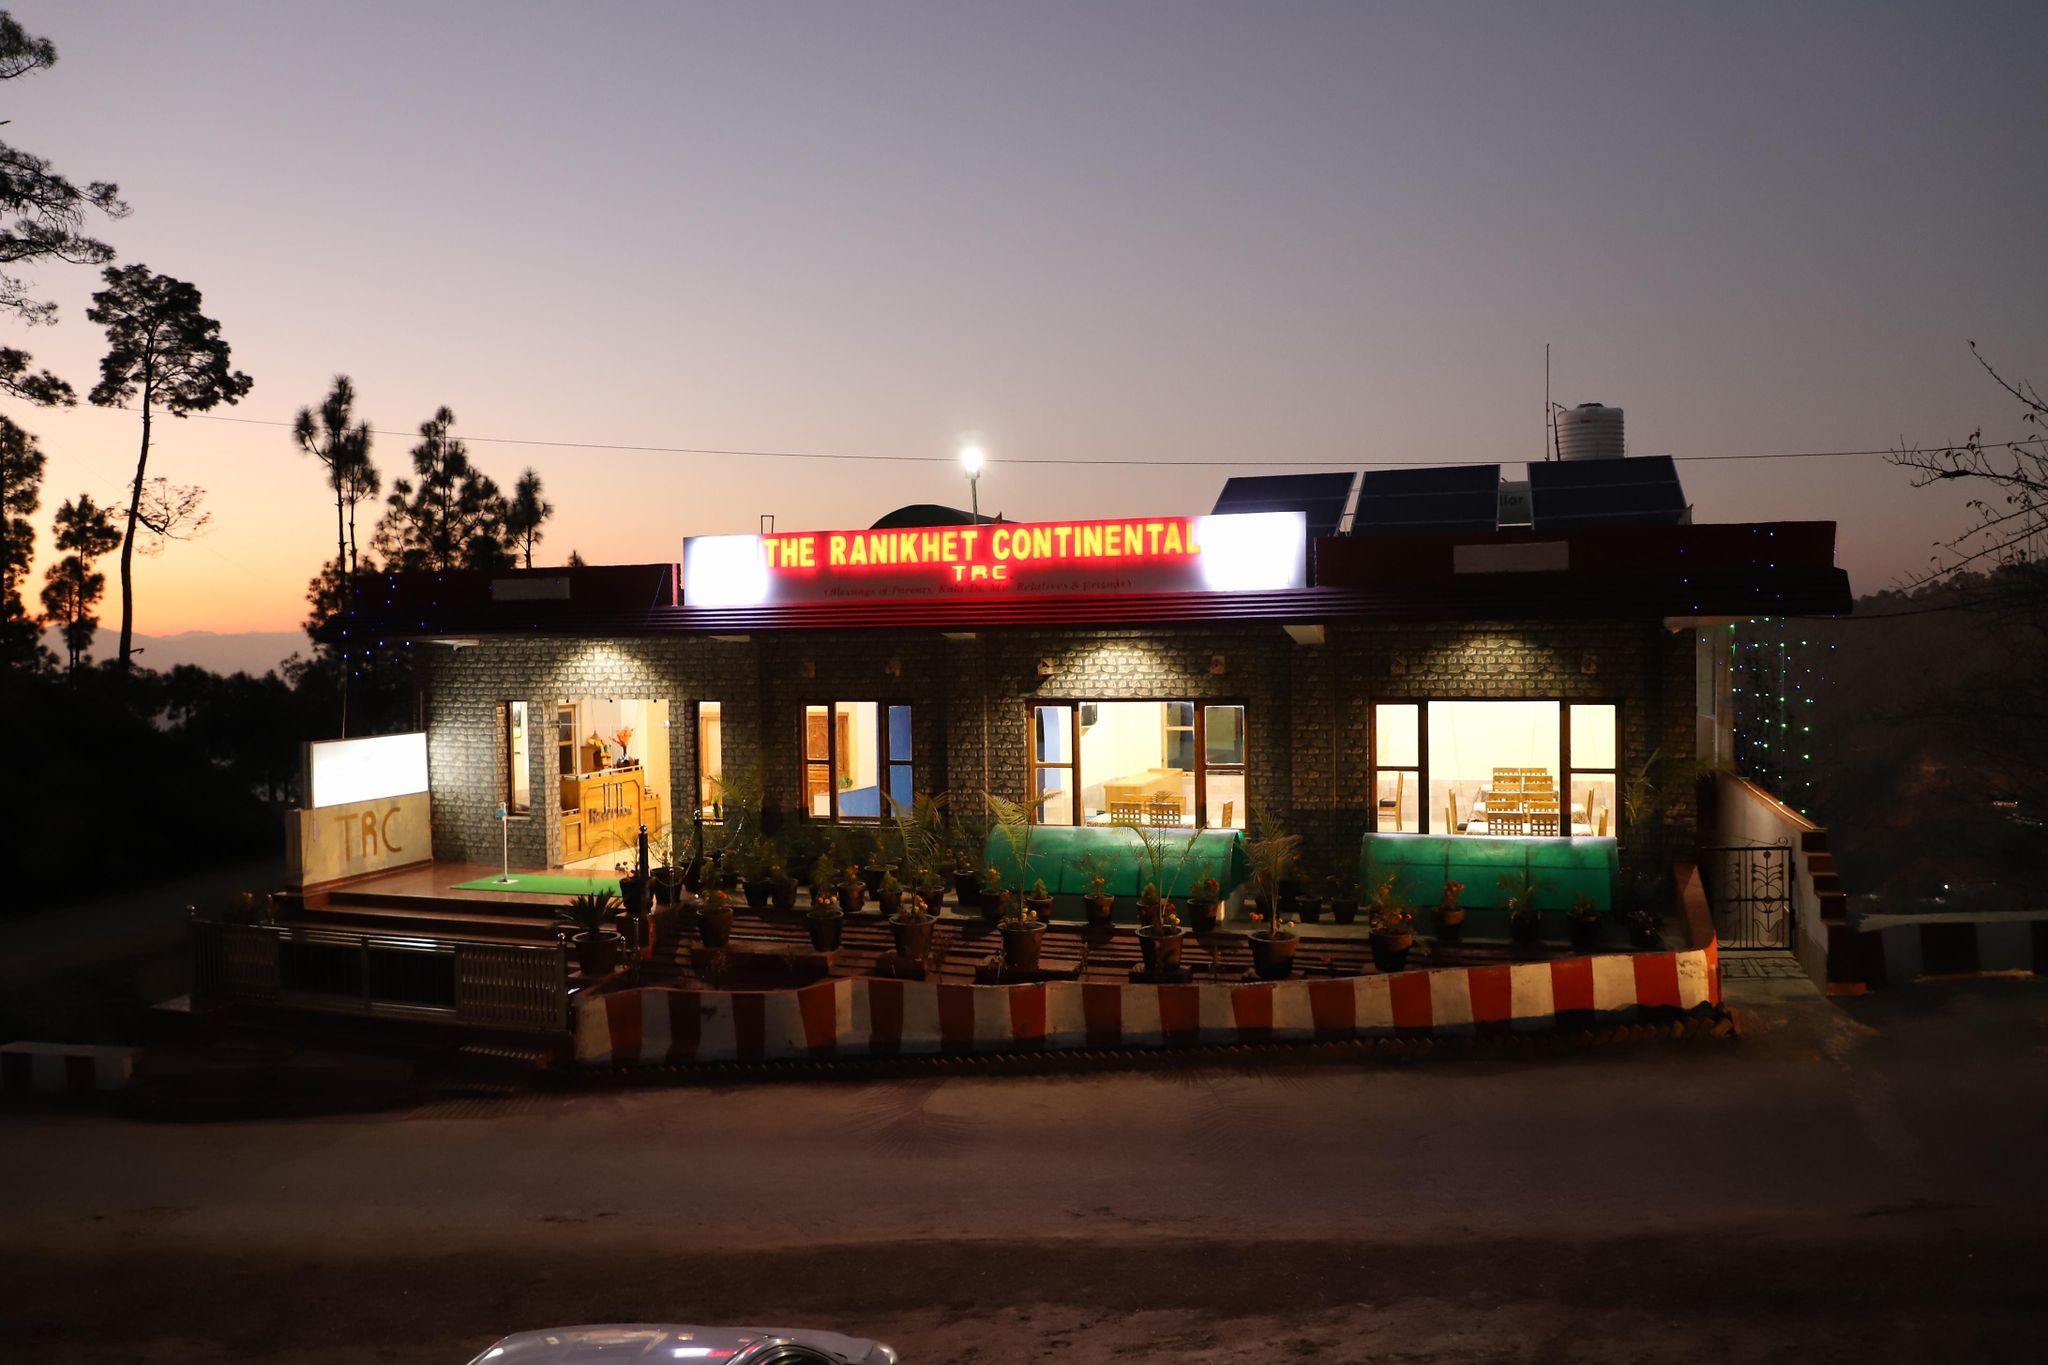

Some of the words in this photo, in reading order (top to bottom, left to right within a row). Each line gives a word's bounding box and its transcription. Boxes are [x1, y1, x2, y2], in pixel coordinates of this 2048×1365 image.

[763, 537, 816, 568] THE
[829, 530, 979, 566] RANIKHET
[992, 522, 1202, 561] CONTINENTAL
[334, 806, 402, 862] TRC
